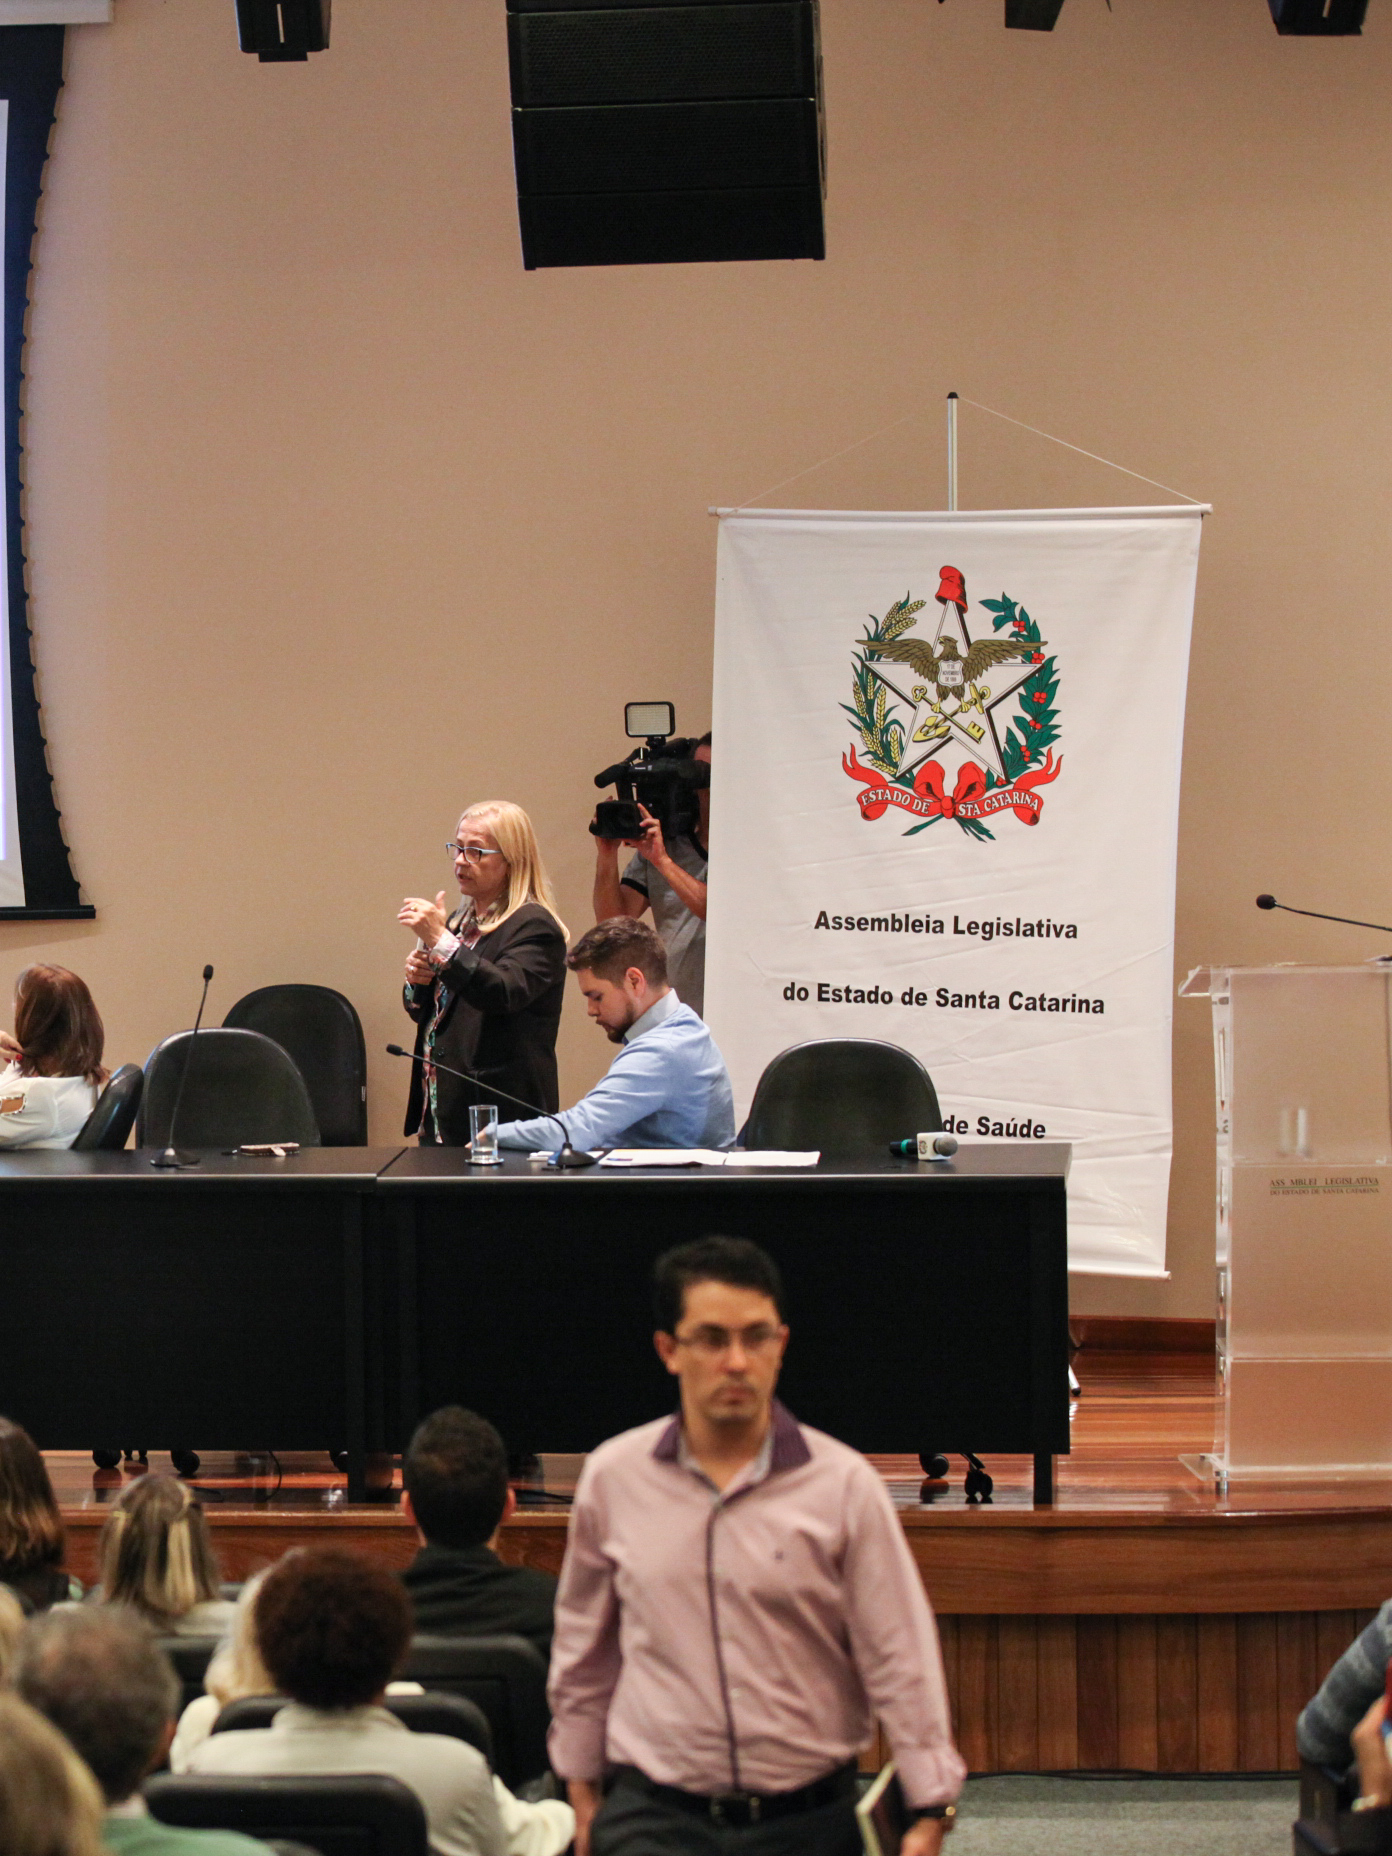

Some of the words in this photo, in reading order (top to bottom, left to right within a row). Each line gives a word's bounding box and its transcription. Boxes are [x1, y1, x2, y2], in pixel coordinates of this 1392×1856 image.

[861, 789, 910, 806] ESTADO
[912, 800, 930, 814] DE
[959, 804, 984, 816] STA.
[984, 791, 1039, 812] CATARINA
[814, 910, 944, 936] Assembleia
[953, 915, 1078, 941] Legislativa
[782, 981, 810, 1002] do
[816, 982, 894, 1006] Estado
[900, 986, 928, 1008] de
[936, 988, 1001, 1010] Santa
[1008, 990, 1105, 1014] Catarina
[943, 1115, 968, 1134] de
[977, 1116, 1046, 1138] Saúde
